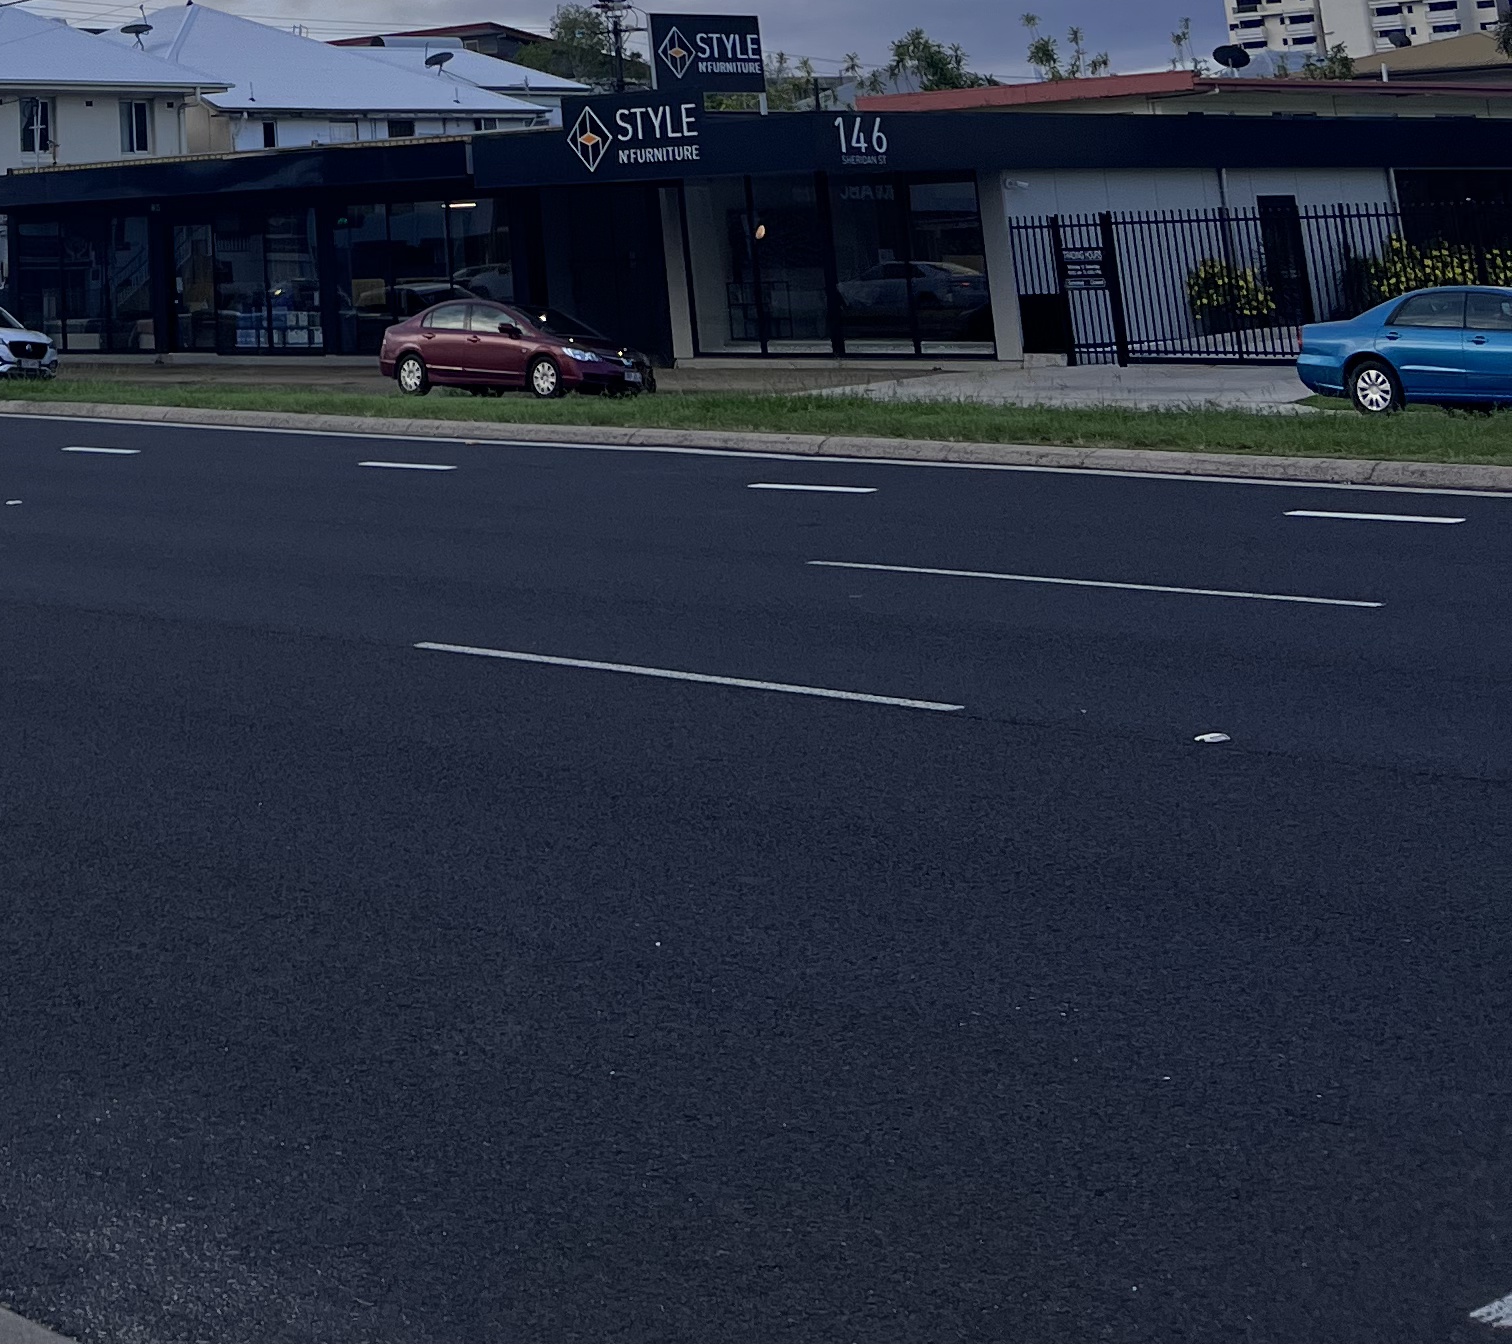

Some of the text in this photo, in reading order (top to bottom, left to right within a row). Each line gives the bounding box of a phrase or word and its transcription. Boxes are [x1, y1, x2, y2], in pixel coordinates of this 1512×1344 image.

[695, 33, 761, 59] STYLE
[615, 103, 699, 141] STYLE
[834, 117, 887, 153] 146
[841, 155, 887, 164] SHERIDAN ST
